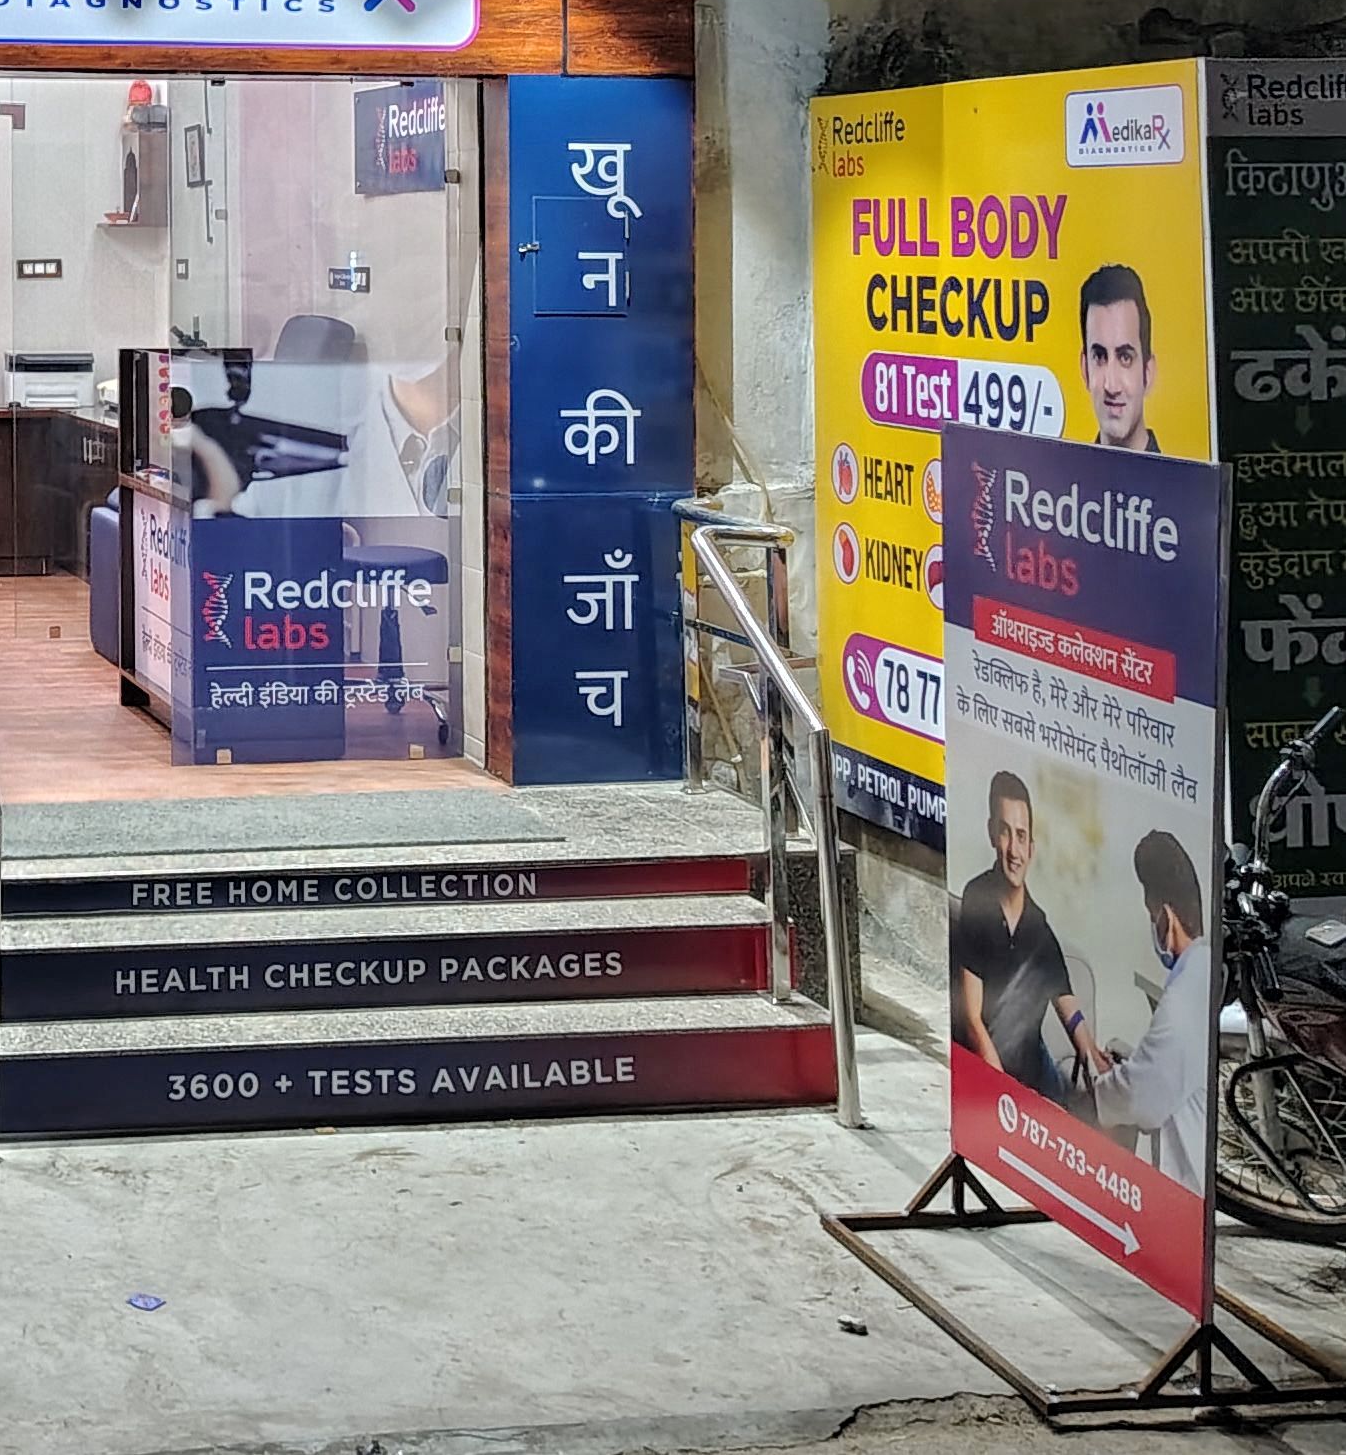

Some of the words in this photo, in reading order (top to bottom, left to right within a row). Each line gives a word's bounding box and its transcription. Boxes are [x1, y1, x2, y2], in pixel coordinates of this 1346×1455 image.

[1247, 73, 1346, 99] Redclif
[388, 96, 446, 138] Redcliffe
[832, 110, 905, 146] Redcliffe
[1248, 102, 1304, 126] labs
[832, 148, 865, 178] labs
[852, 197, 940, 257] FULL
[950, 194, 1068, 260] BODY
[866, 273, 1050, 343] CHECKUP
[1229, 275, 1286, 313] और
[874, 361, 898, 414] 81
[903, 364, 953, 420] Test
[963, 370, 1054, 434] 499/-
[863, 455, 914, 507] HEART
[1004, 468, 1179, 562] Redcliffe
[149, 558, 170, 601] labs
[865, 537, 923, 592] KIDNEY
[1005, 529, 1081, 597] labs
[244, 569, 432, 610] Redcliffe
[244, 612, 331, 651] labs
[991, 609, 1055, 654] ऑथराइज्ड
[1057, 631, 1119, 676] कलेक्शन
[1120, 647, 1154, 685] सेंटर
[210, 681, 254, 709] हेल्दी
[258, 680, 310, 709] इंडिया
[313, 679, 340, 704] की
[343, 678, 391, 709] ट्रस्टेड
[394, 677, 425, 703] लैब
[883, 657, 910, 714] 78
[916, 668, 941, 725] 77
[972, 648, 1030, 696] रेडक्लिफ
[1050, 675, 1070, 712] मेरे
[1072, 684, 1098, 721] और
[1102, 693, 1122, 730] मेरे
[1126, 706, 1176, 749] परिवार
[956, 684, 971, 718] के
[973, 692, 999, 729] लिए
[1038, 720, 1098, 768] भरोसेमंद
[1100, 737, 1168, 793] पैथोलॉजी
[857, 763, 905, 807] PETROL
[131, 882, 214, 907] FREE
[227, 878, 320, 905] HOME
[333, 872, 539, 902] COLLECTION
[115, 965, 251, 995] HEALTH
[263, 958, 427, 990] CHECKUP
[440, 951, 624, 983] PACKAGES
[166, 1071, 260, 1102] 3600
[308, 1068, 417, 1097] TESTS
[431, 1056, 636, 1094] AVAILABLE
[1020, 1112, 1142, 1213] 787-733-4488
